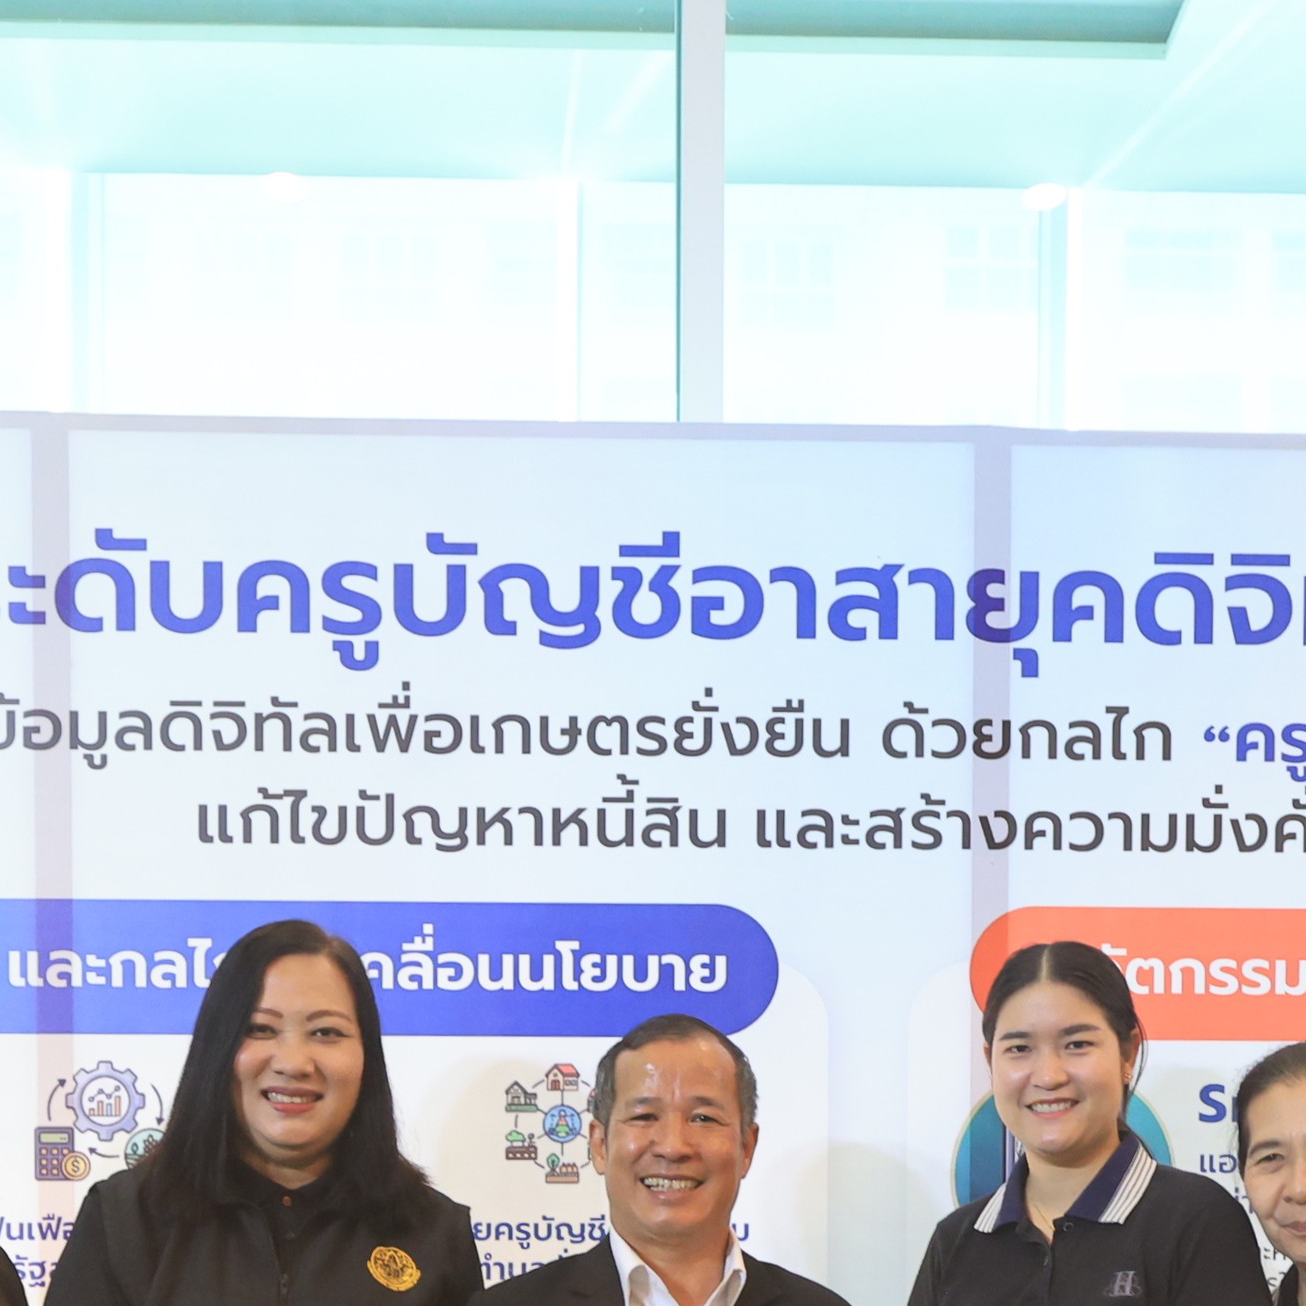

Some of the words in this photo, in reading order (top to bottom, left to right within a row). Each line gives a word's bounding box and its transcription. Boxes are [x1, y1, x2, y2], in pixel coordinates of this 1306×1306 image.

[882, 701, 1173, 761] ด้วยกลไก
[197, 774, 726, 852] แก้ไขปัญหาหนี้สิน
